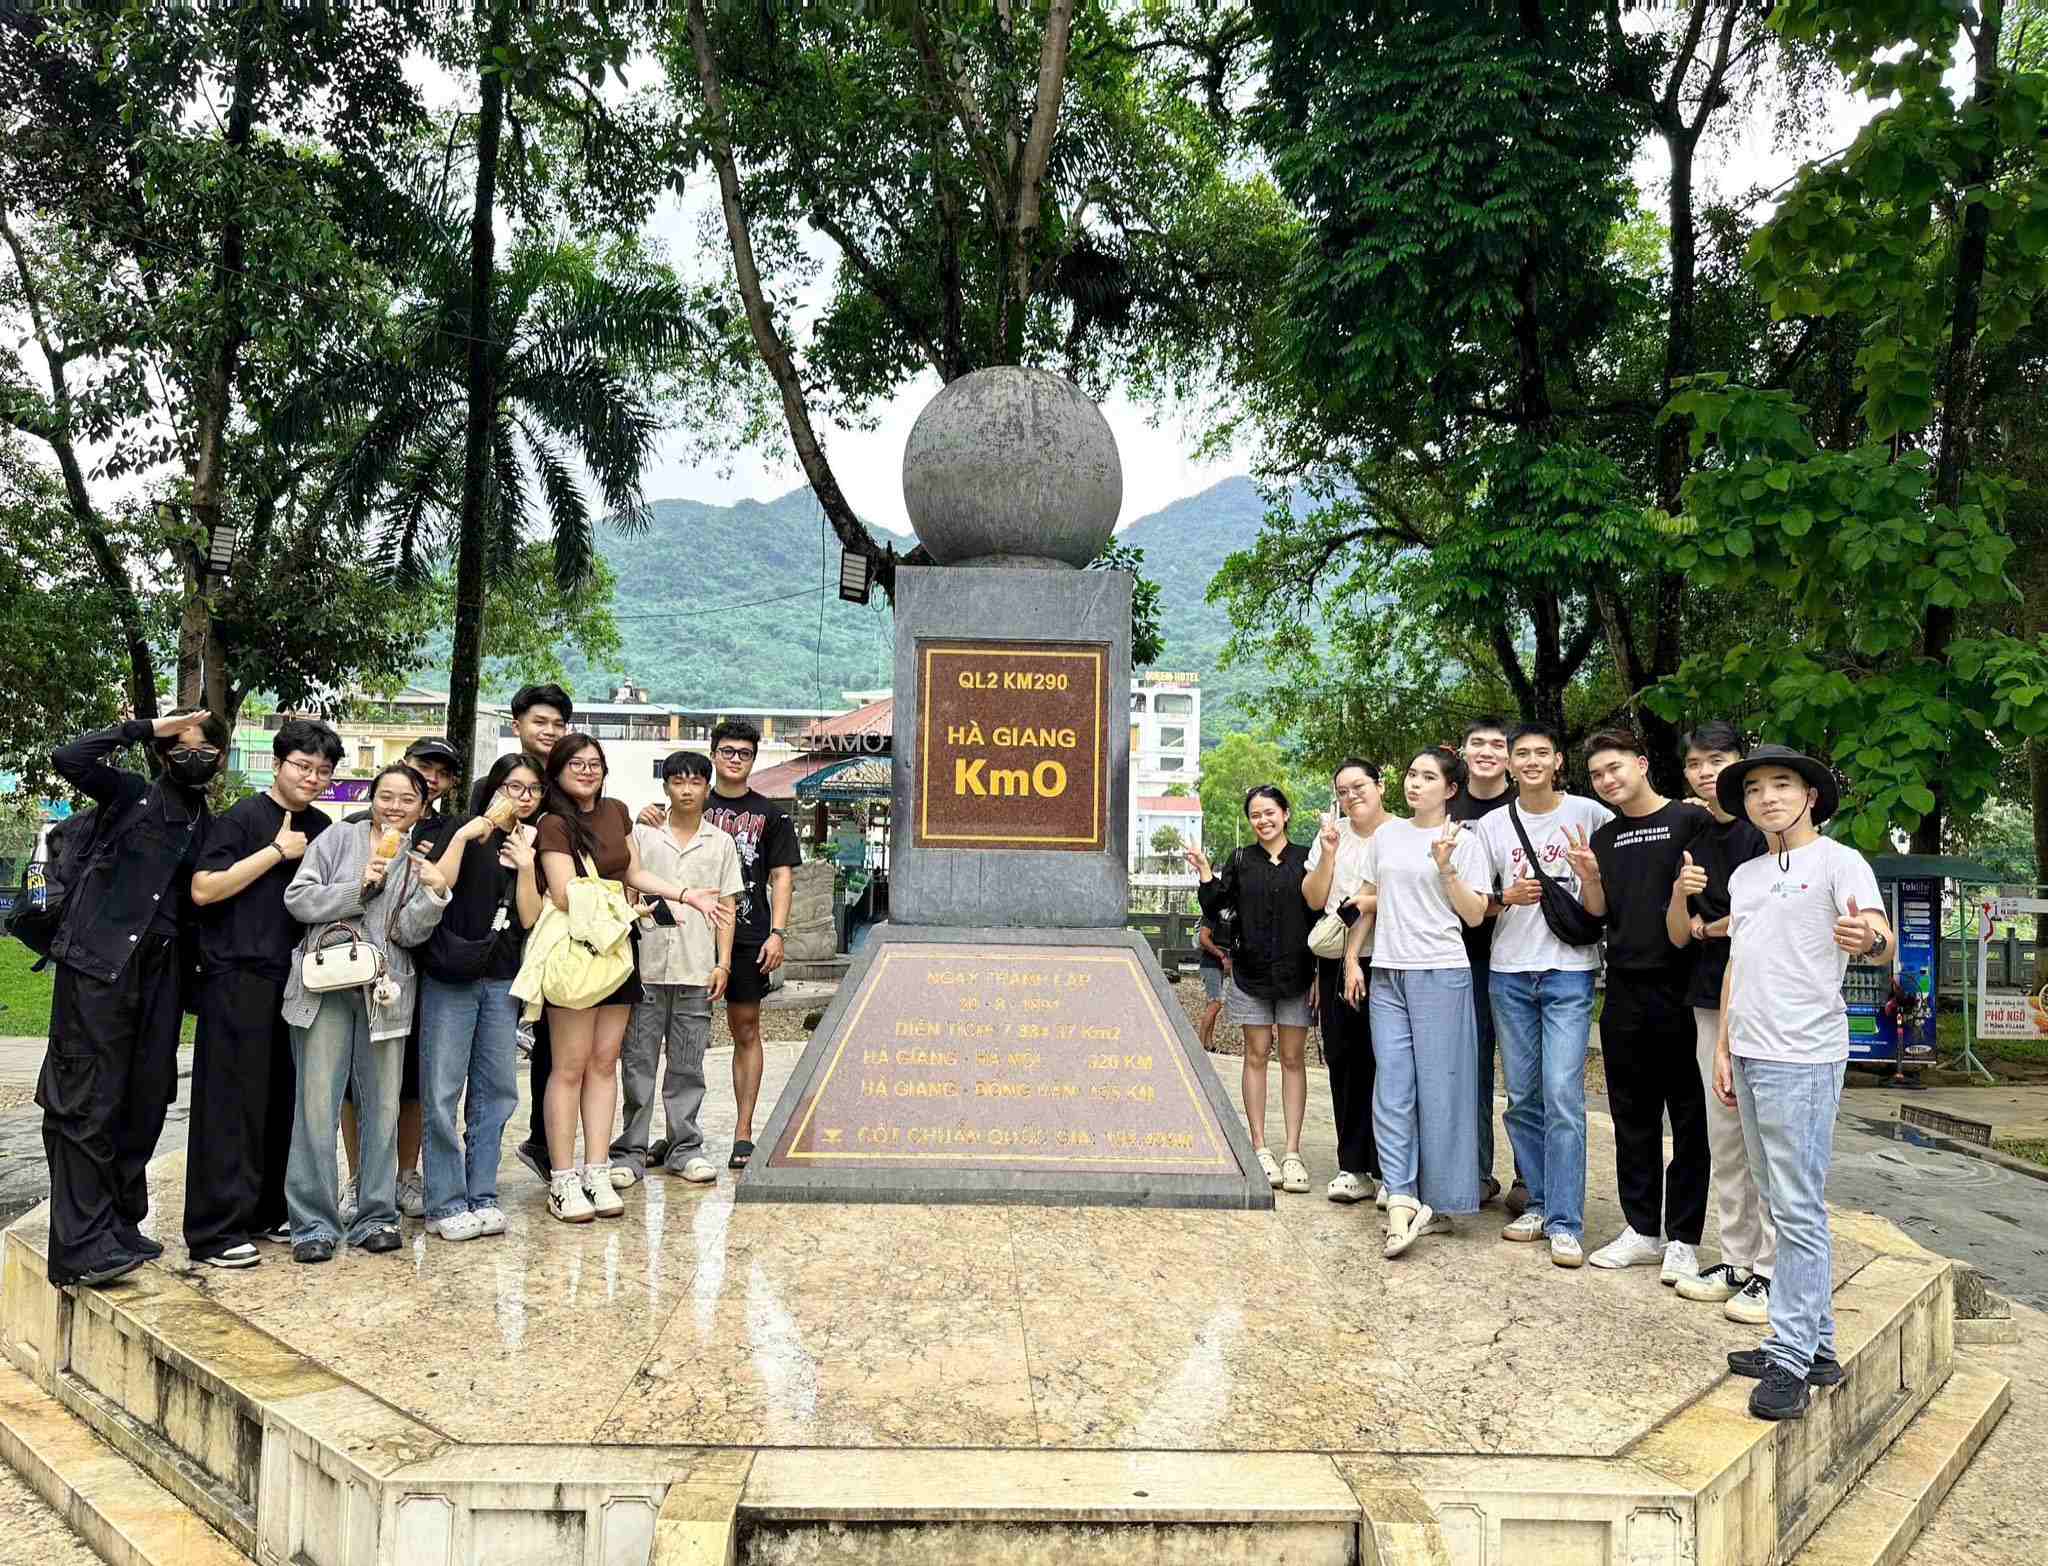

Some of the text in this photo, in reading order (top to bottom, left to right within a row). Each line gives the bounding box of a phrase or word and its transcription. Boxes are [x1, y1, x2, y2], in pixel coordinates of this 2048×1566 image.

[958, 672, 1068, 690] QL2 KM290
[947, 720, 1077, 748] HÀ GIANG
